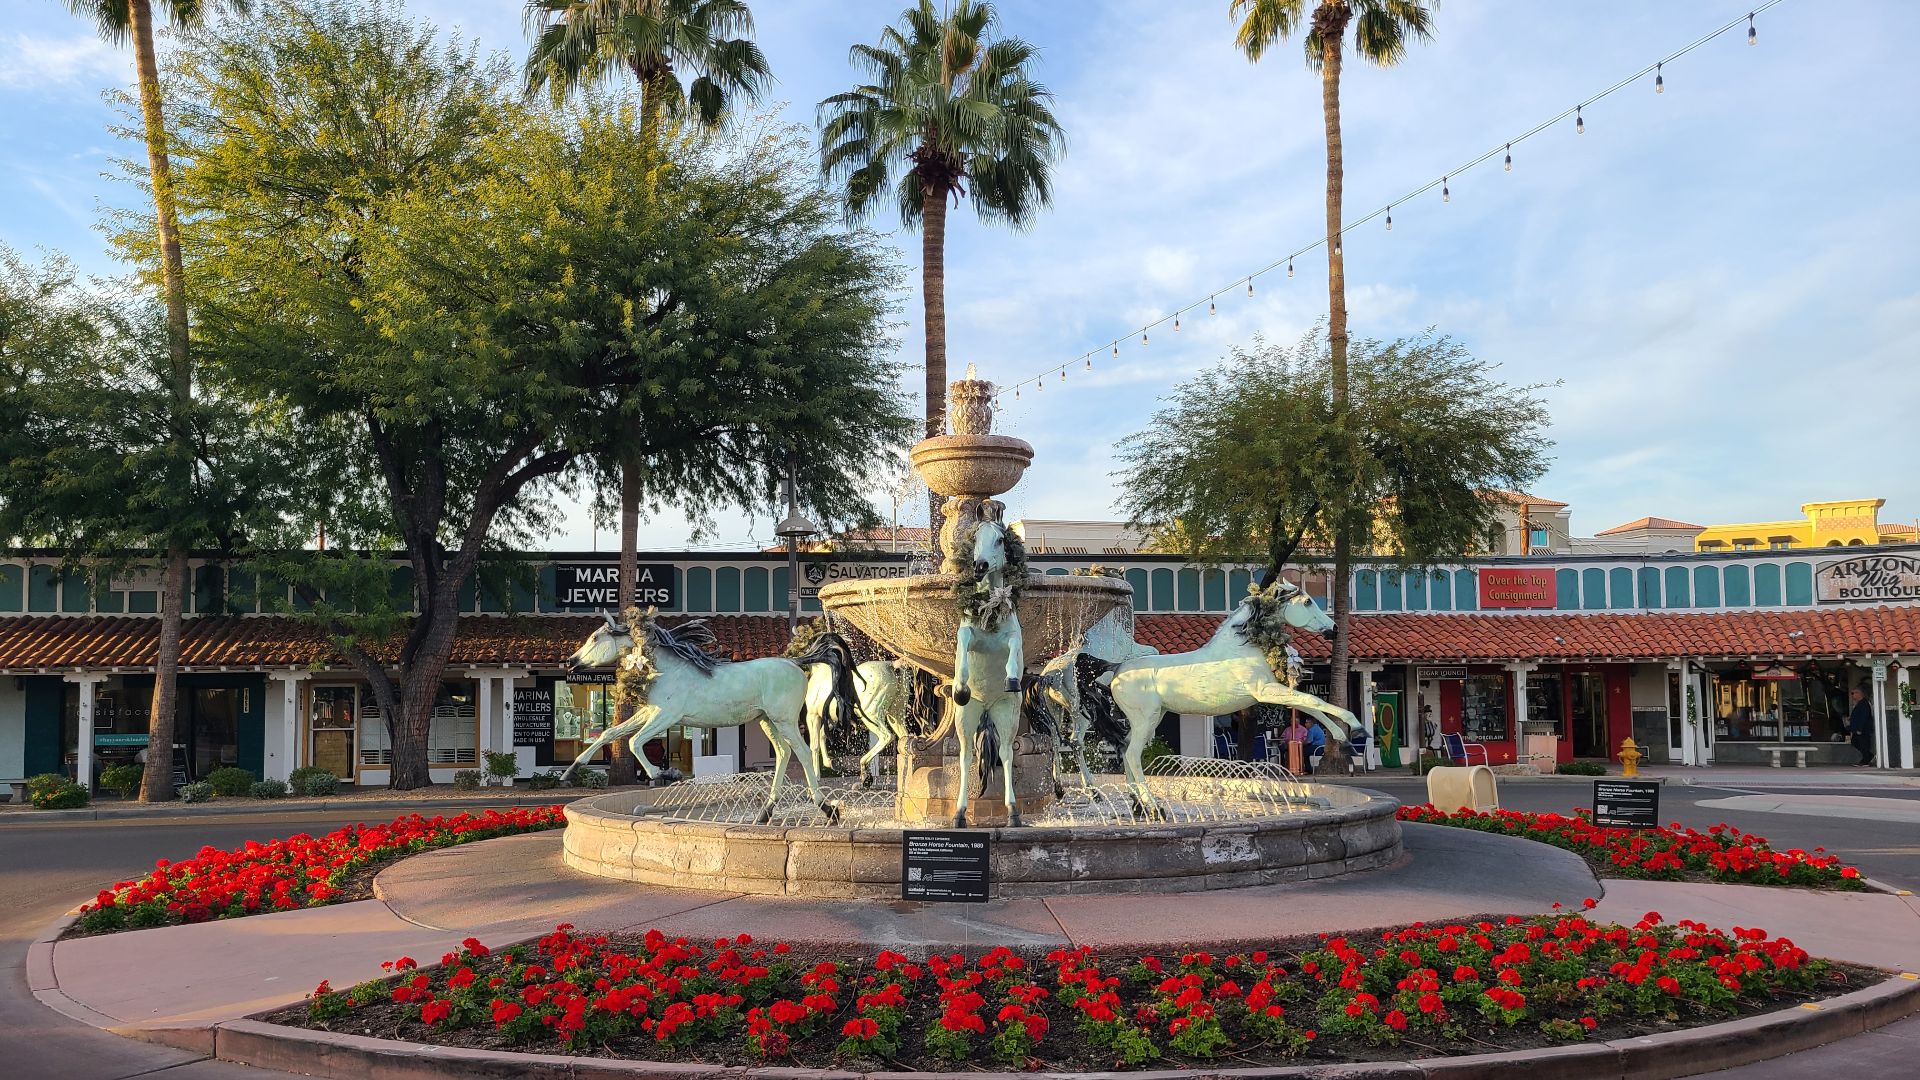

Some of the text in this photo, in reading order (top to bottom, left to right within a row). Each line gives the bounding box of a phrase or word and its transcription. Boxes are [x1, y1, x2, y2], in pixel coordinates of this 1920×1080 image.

[576, 568, 654, 583] MARA
[829, 563, 906, 579] SALVATORE
[1488, 574, 1547, 588] Over the Top
[1857, 569, 1901, 589] Wig
[562, 588, 669, 603] JEWEERS
[1489, 589, 1547, 603] Consignment
[1306, 684, 1330, 694] JAVEL
[514, 702, 552, 712] EWELERS
